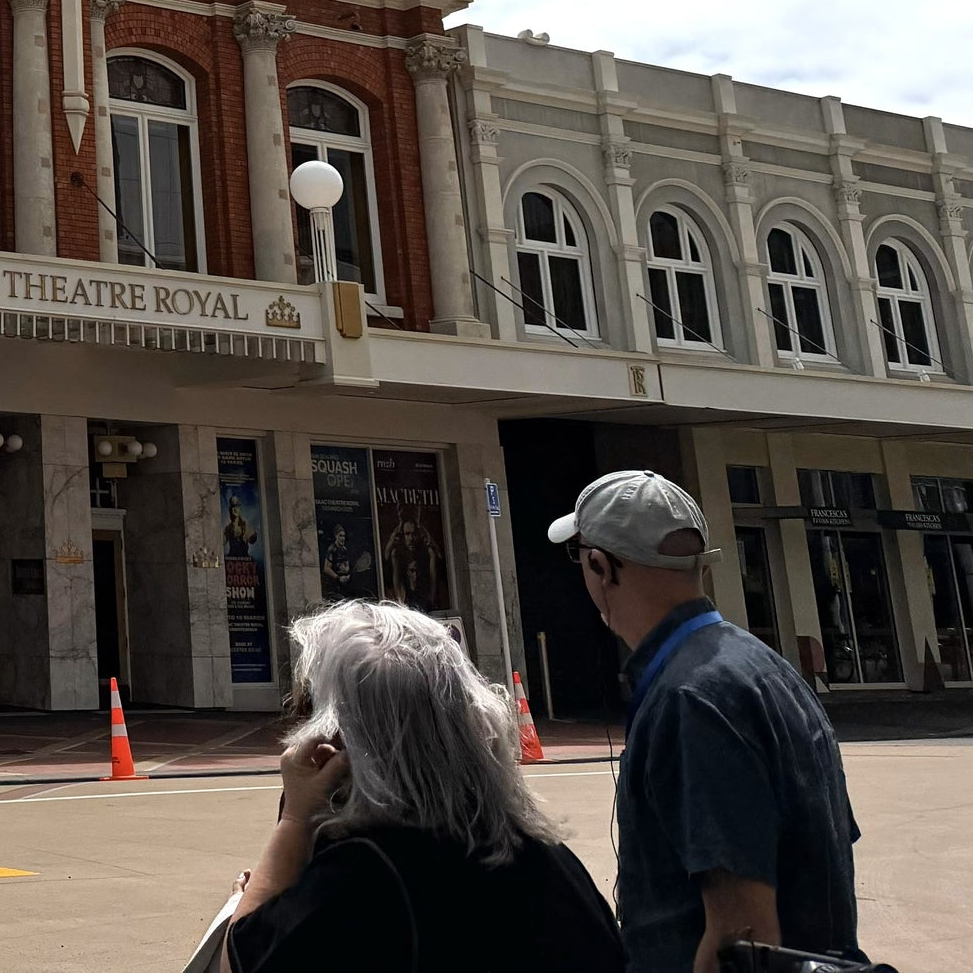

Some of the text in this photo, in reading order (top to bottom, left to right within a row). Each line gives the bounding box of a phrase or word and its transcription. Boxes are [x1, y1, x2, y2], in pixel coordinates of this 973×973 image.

[3, 270, 147, 310] THEATRE
[153, 285, 248, 320] ROYAL
[311, 459, 358, 475] SQUASH
[377, 487, 439, 506] MACBETH
[226, 561, 258, 574] OCKY
[227, 574, 260, 586] ORROR
[226, 587, 255, 599] SHOW
